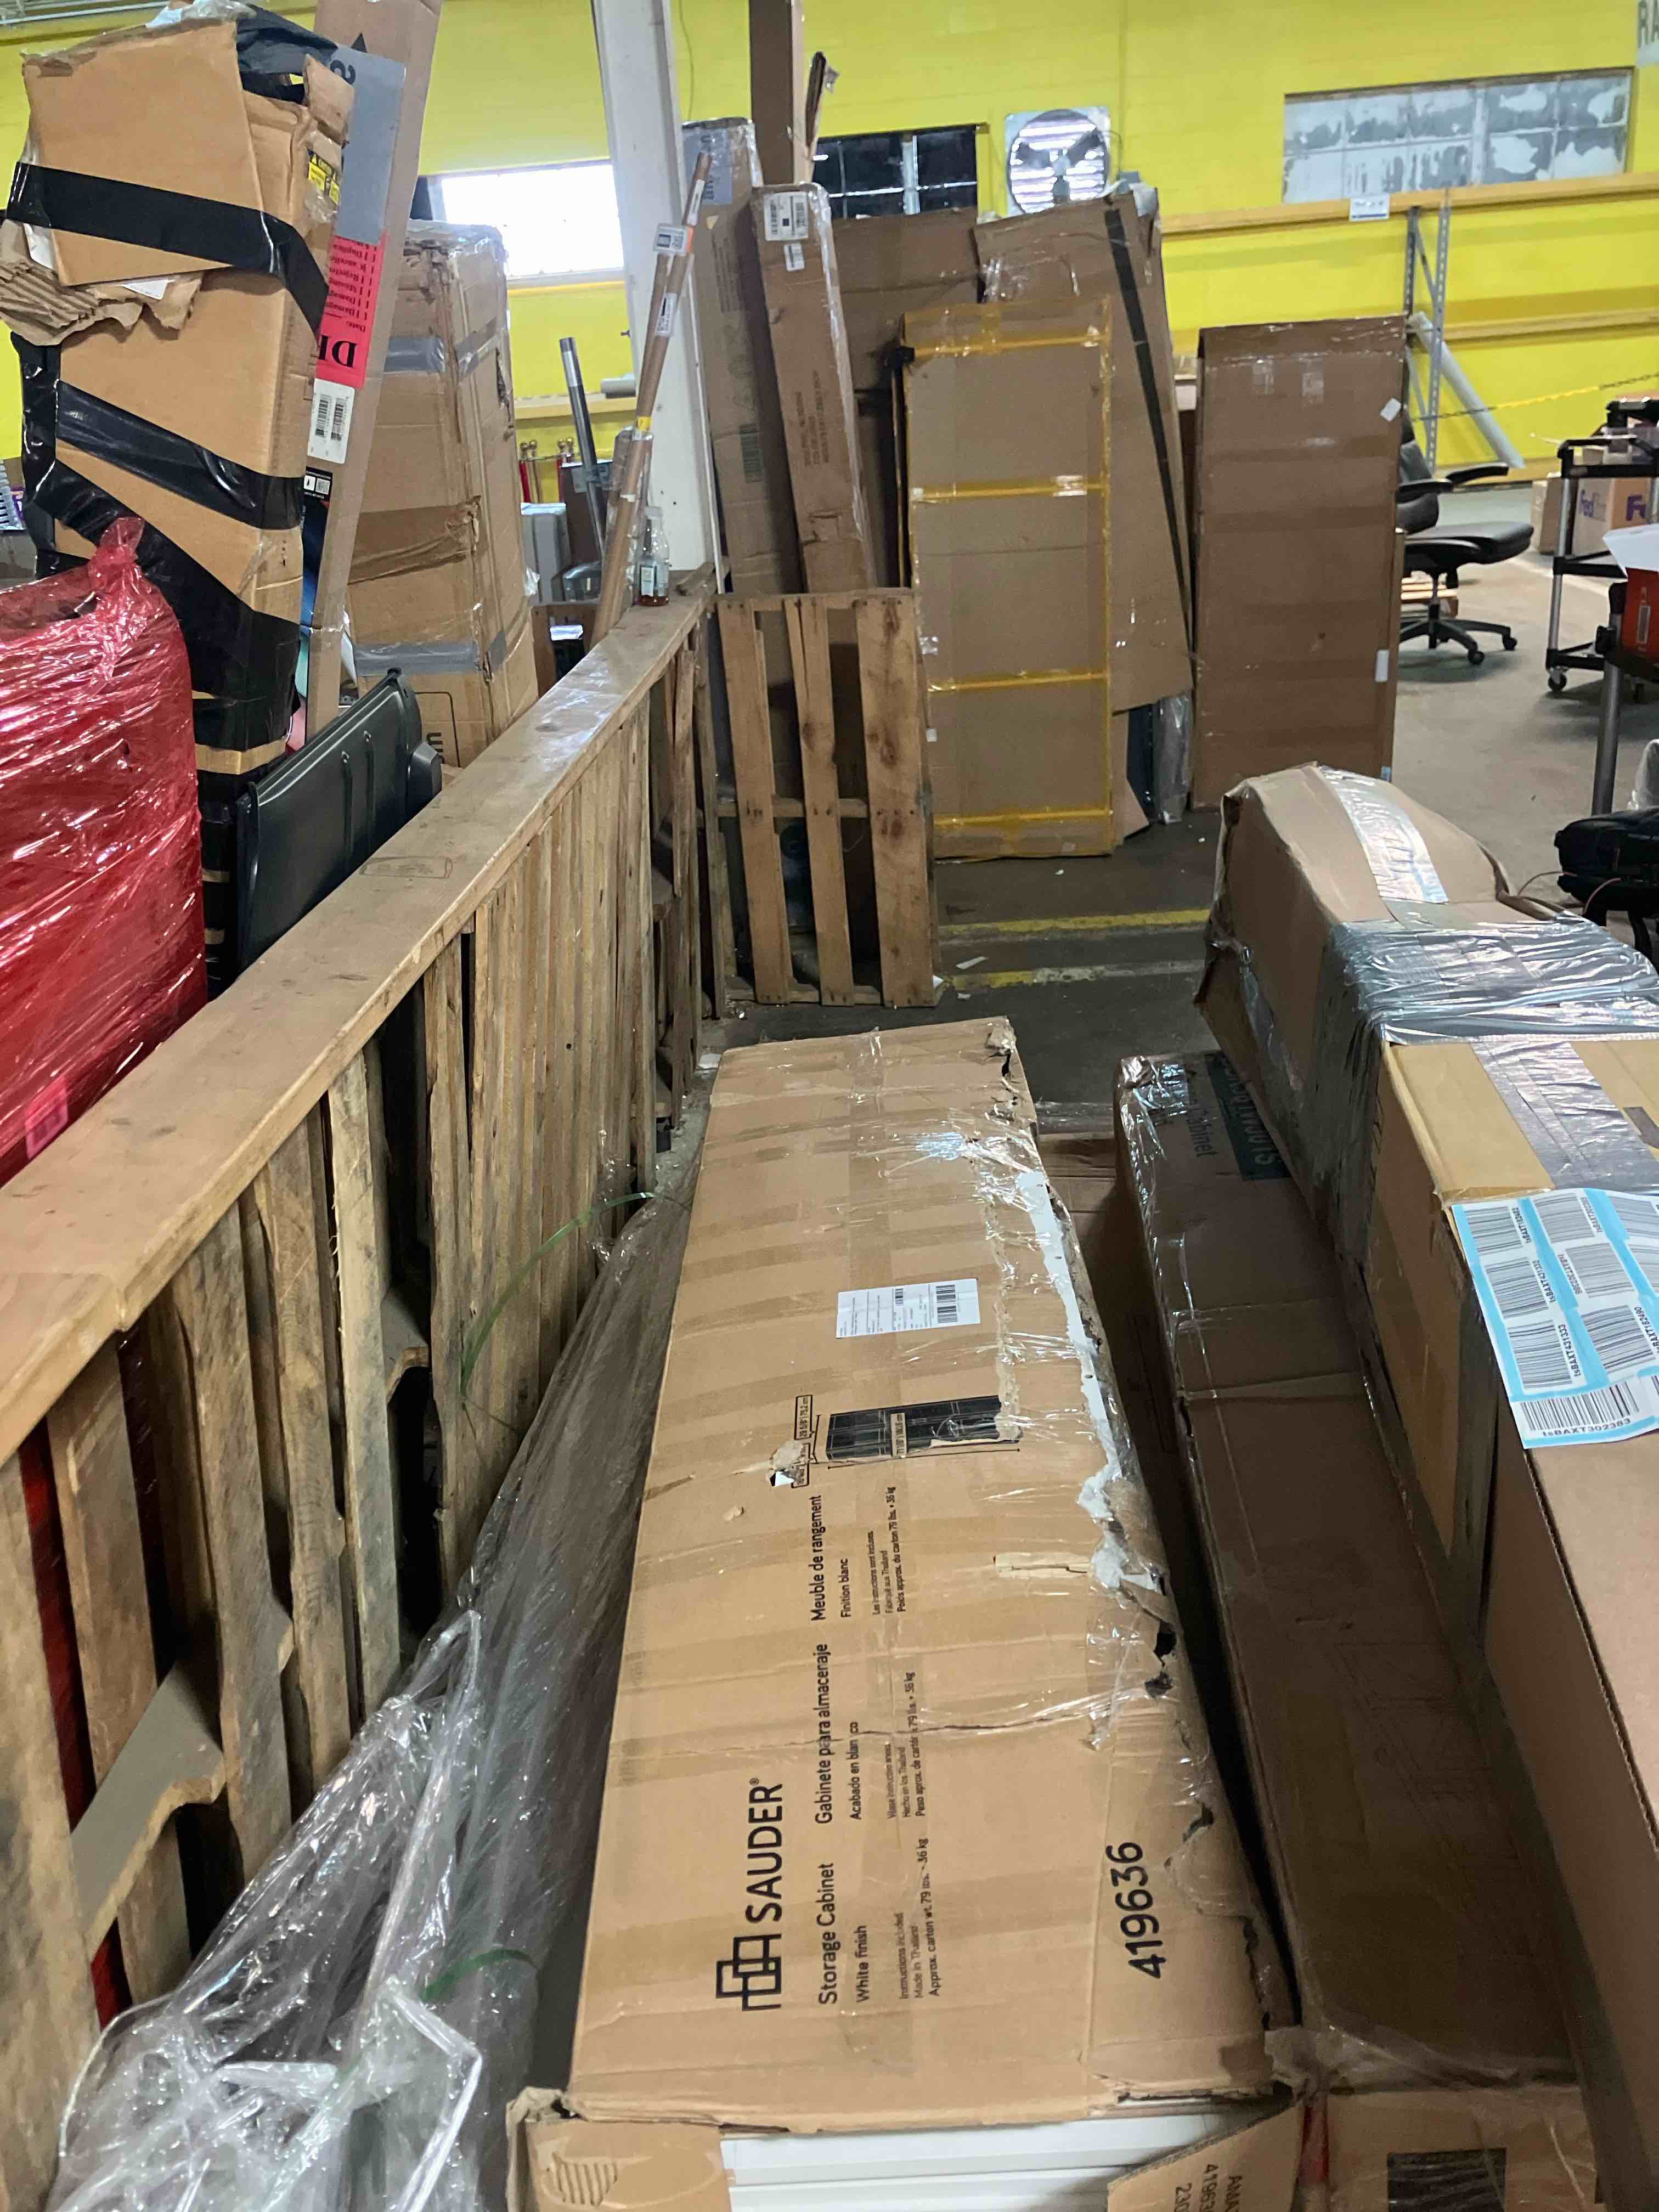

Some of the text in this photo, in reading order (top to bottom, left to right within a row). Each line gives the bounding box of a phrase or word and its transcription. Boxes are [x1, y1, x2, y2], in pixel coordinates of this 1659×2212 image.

[891, 1531, 900, 1553] carton
[808, 1495, 826, 1621] Meuble de rangement
[892, 1554, 901, 1564] du
[838, 1558, 851, 1618] Finition blanc
[812, 1644, 831, 1718] almacenaje
[849, 1762, 860, 1774] en
[911, 1759, 922, 1769] de
[814, 1760, 833, 1824] Gabinete
[847, 1776, 862, 1820] Acabado
[915, 1796, 926, 1816] Peso
[916, 1838, 929, 1849] kg
[917, 1850, 928, 1864] 36
[920, 1891, 932, 1905] 79
[1105, 1842, 1167, 1979] 419636
[923, 1905, 933, 1919] wt.
[814, 1863, 840, 2005] Storage Cabinet
[926, 1921, 936, 1952] carton
[854, 1925, 870, 2003] White finish
[912, 1962, 922, 1972] in
[927, 1954, 941, 1997] Approx.
[913, 1973, 923, 1999] Made
